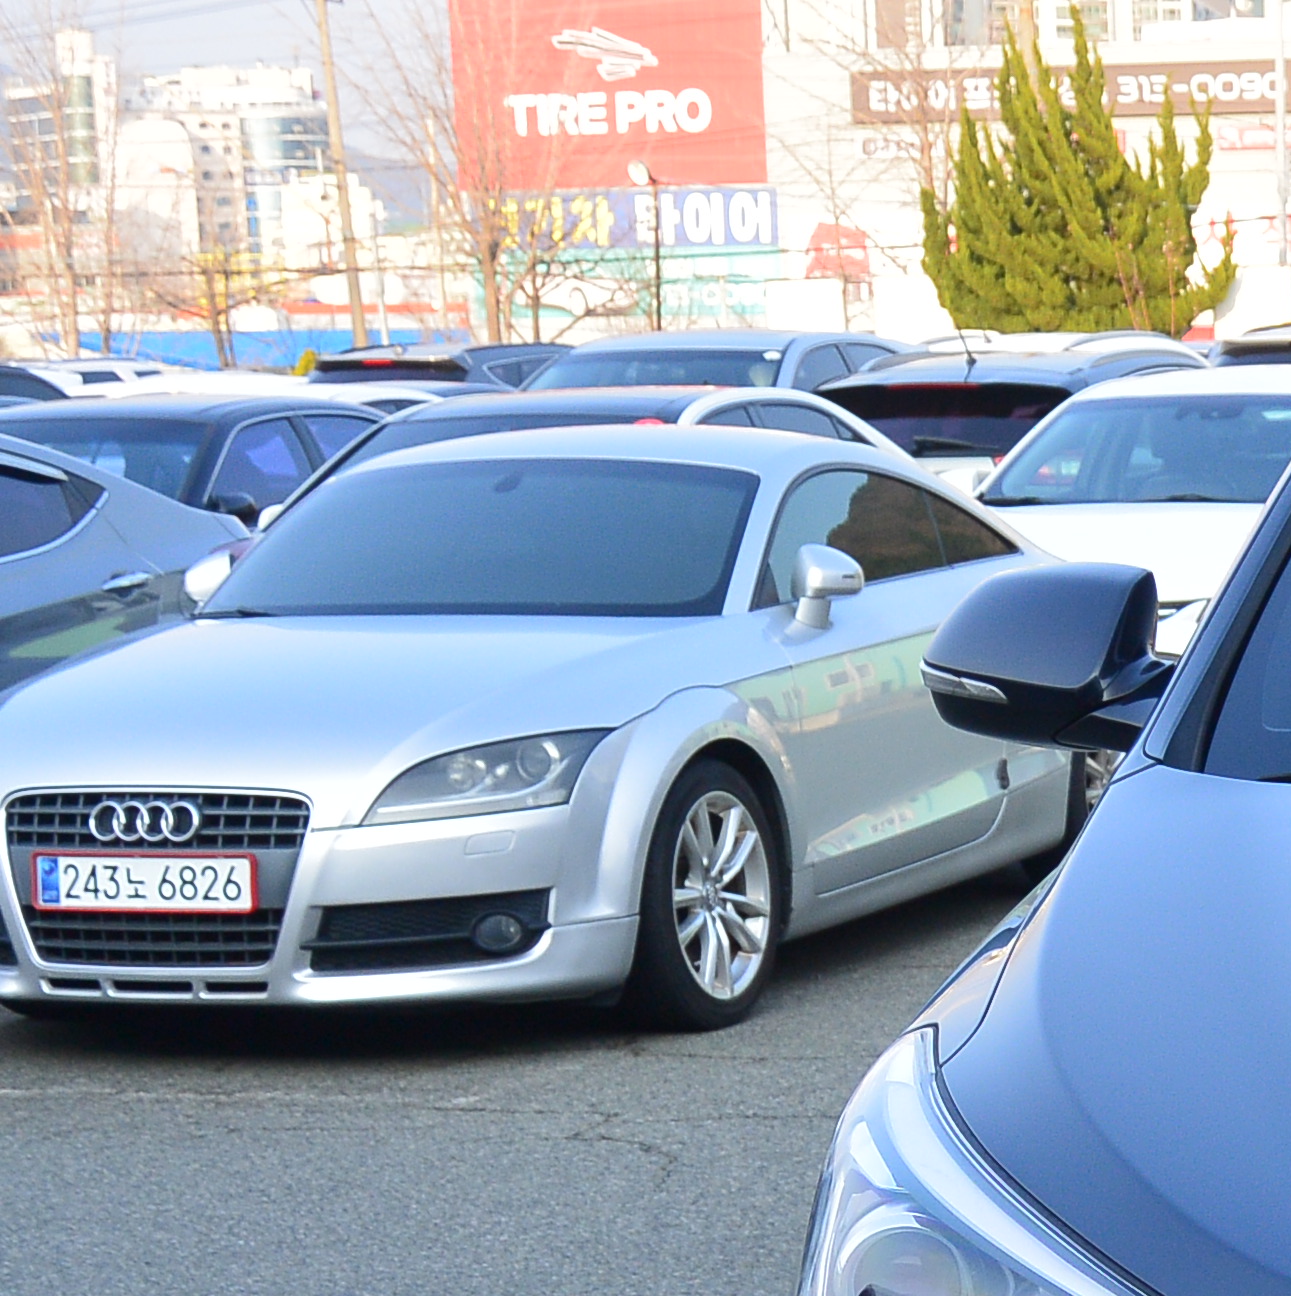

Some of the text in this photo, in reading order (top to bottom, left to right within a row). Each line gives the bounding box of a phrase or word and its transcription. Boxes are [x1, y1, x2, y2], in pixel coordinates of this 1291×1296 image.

[503, 87, 713, 137] TIRE PRO
[633, 190, 772, 247] 타이어
[63, 864, 242, 901] 243노 6826
